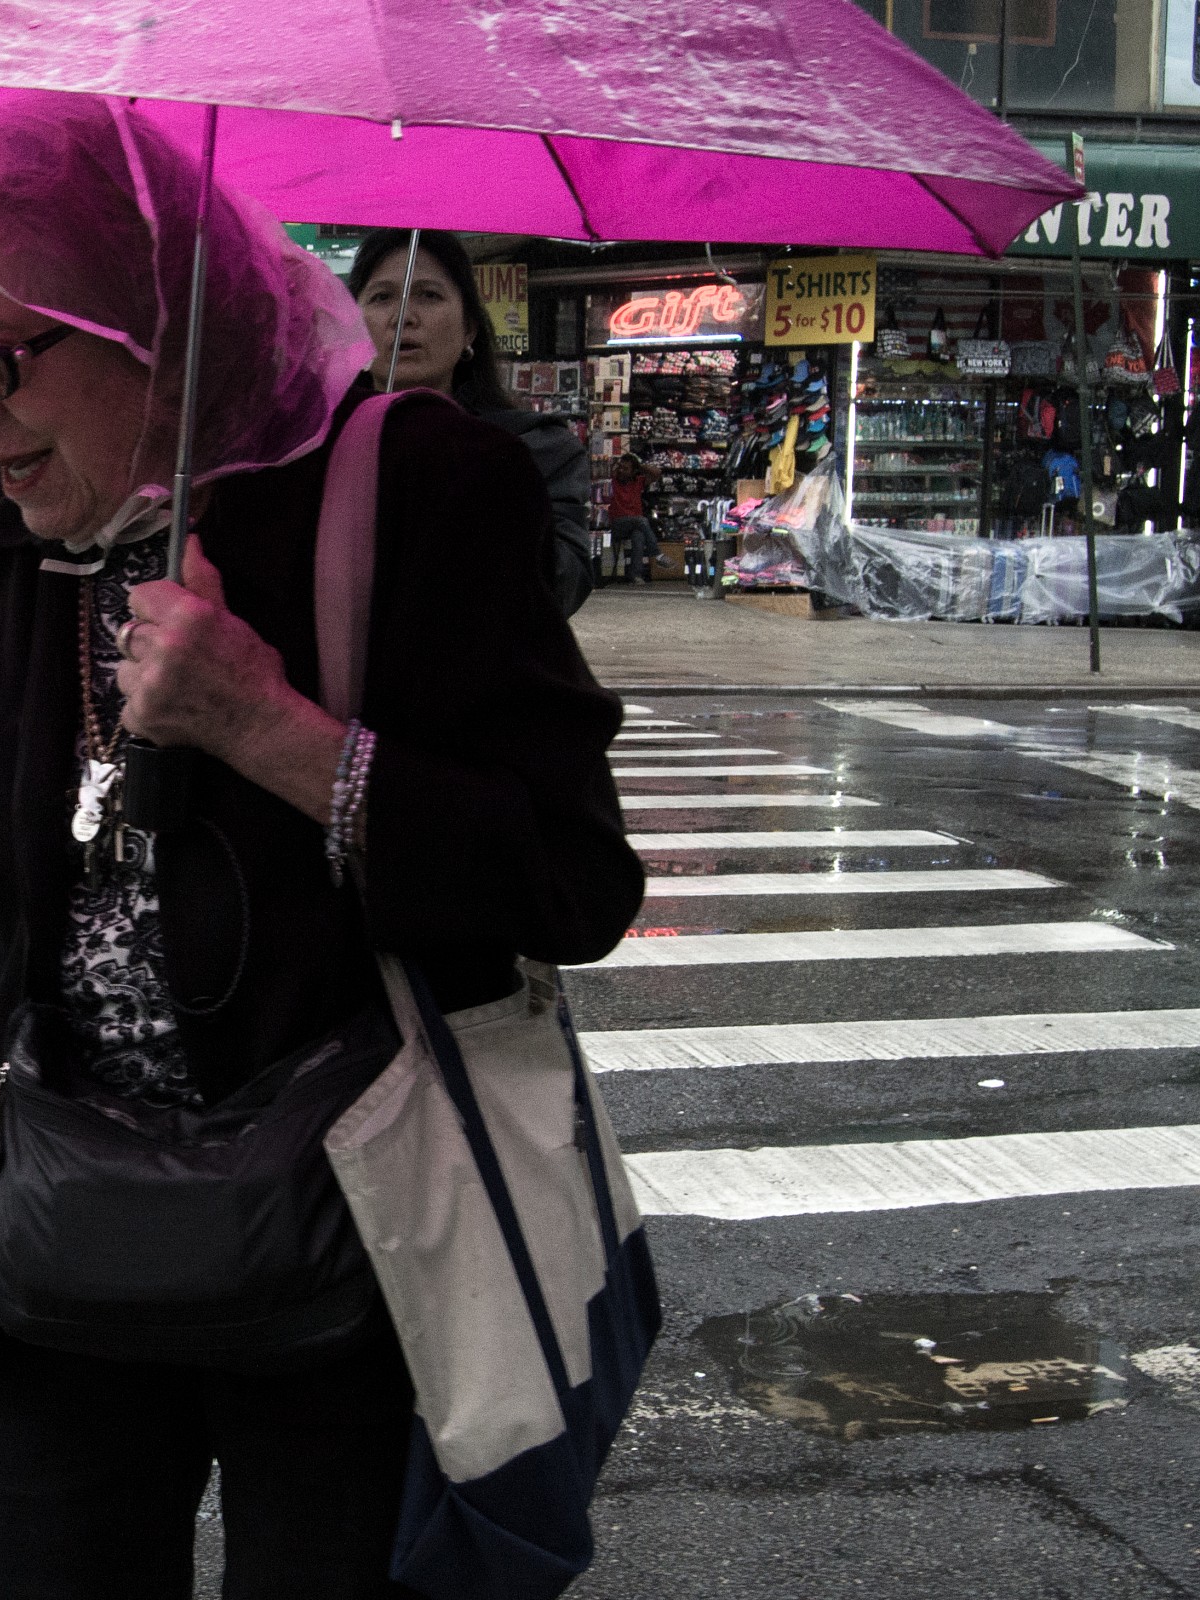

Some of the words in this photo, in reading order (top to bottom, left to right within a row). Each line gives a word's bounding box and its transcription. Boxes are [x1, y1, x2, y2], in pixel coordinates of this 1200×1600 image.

[1012, 191, 1171, 248] NTER
[475, 265, 528, 302] UME
[771, 269, 872, 300] T-SHIRTS
[609, 284, 743, 337] Gift
[773, 304, 793, 338] 5
[795, 312, 817, 327] for
[820, 302, 867, 334] $10
[983, 358, 1003, 367] YORK
